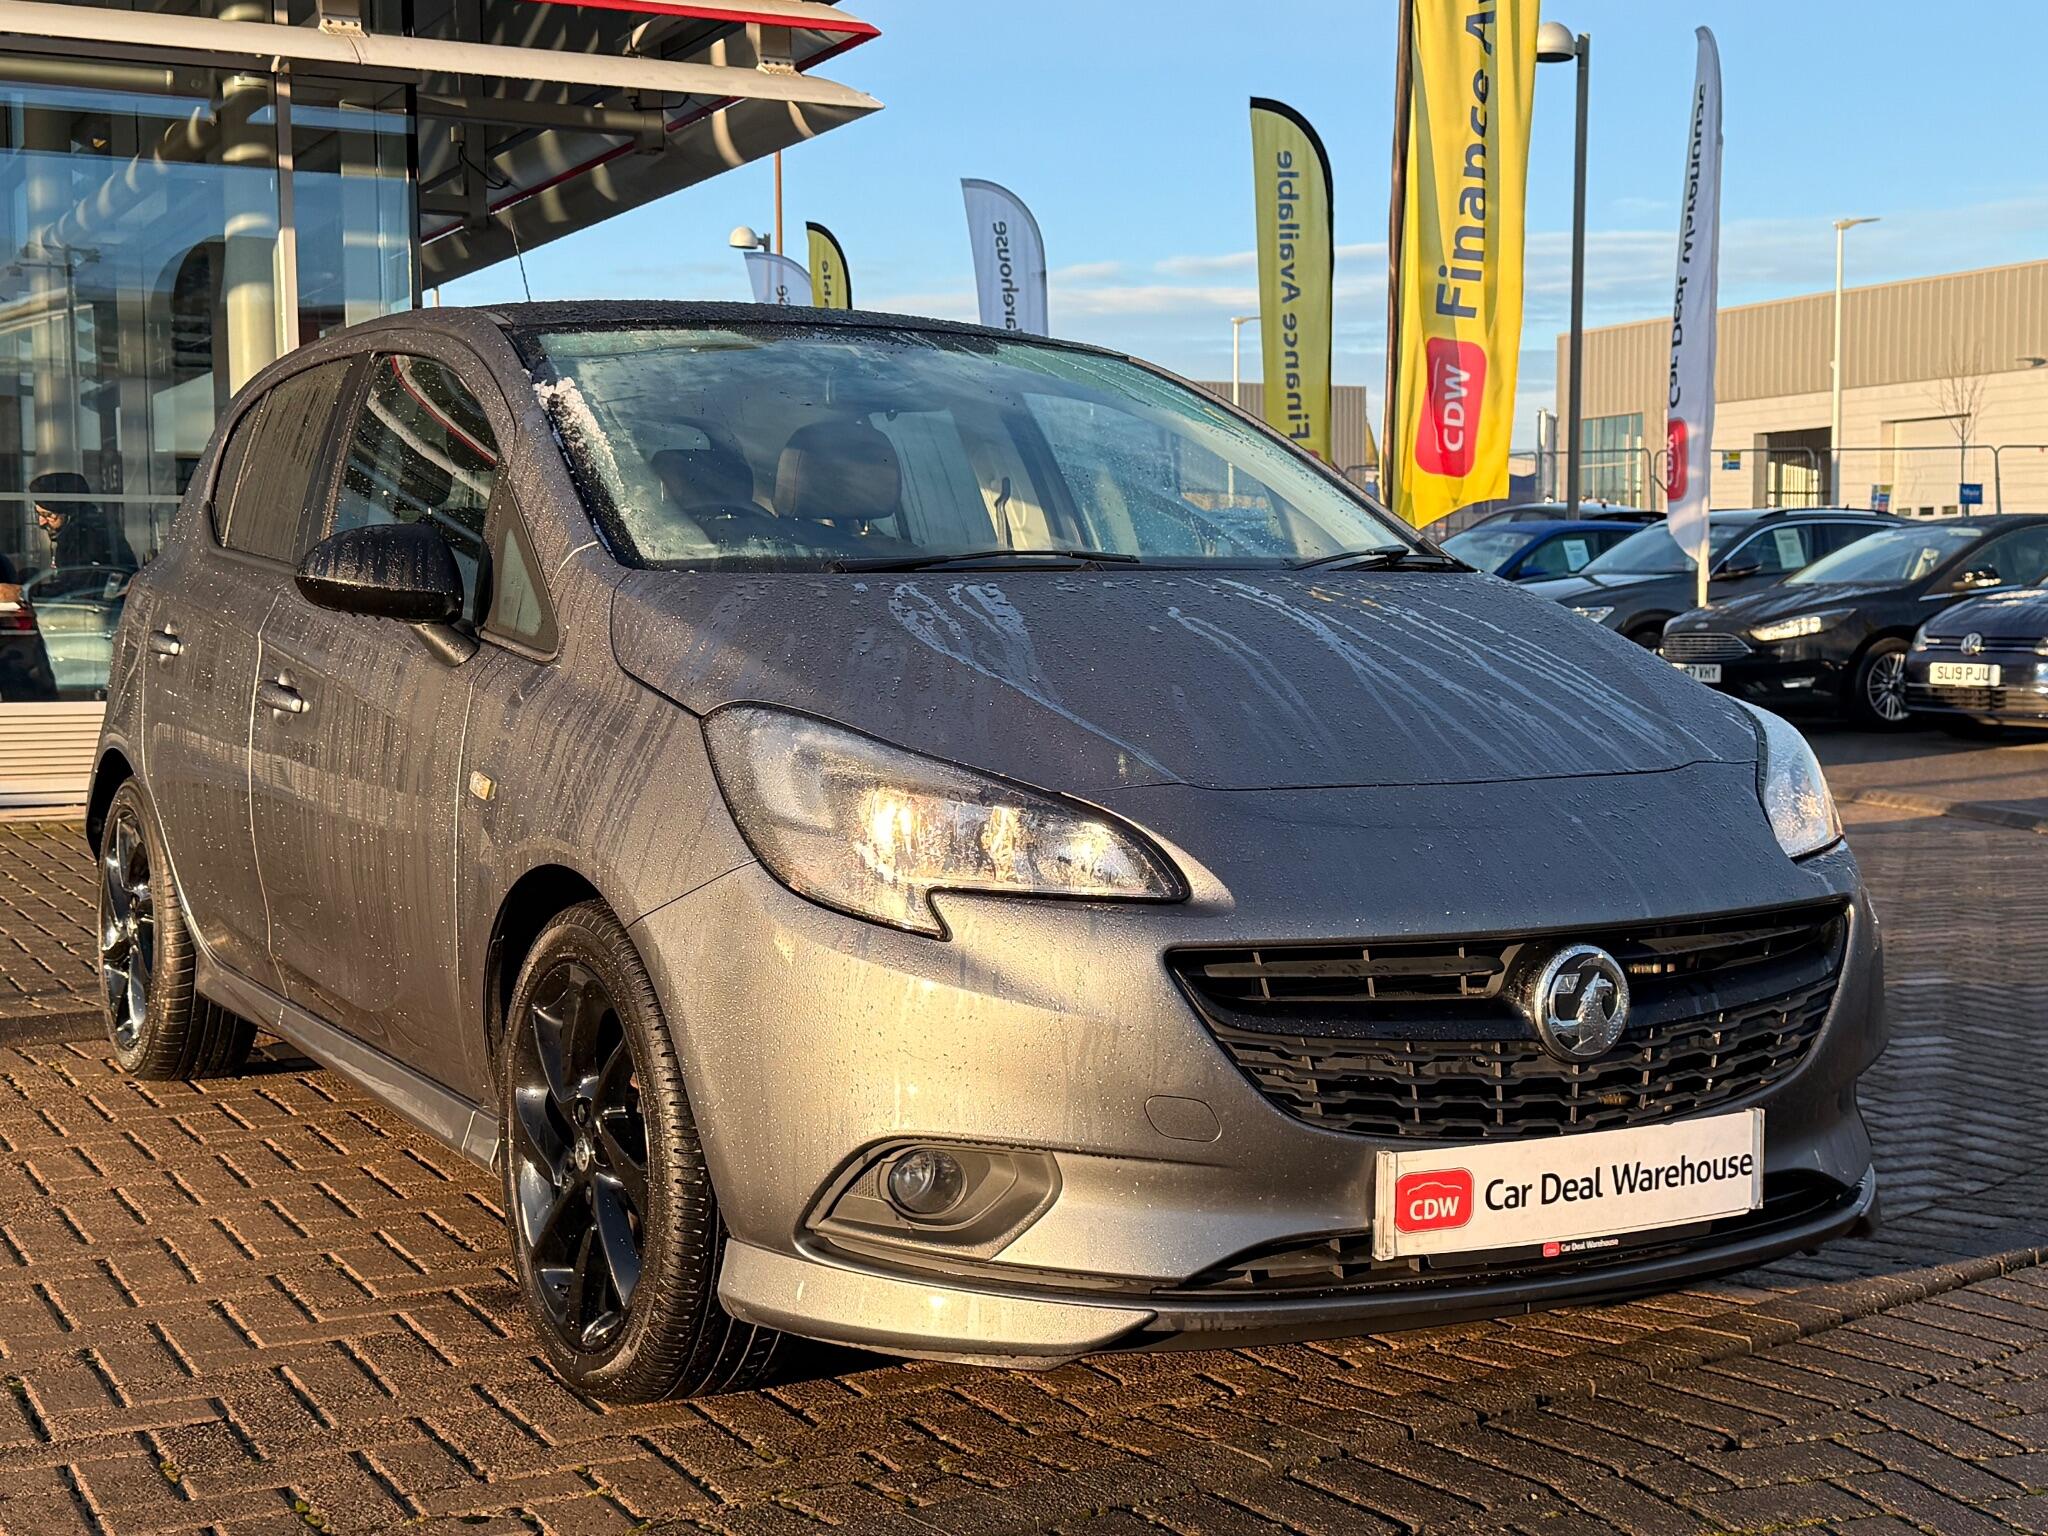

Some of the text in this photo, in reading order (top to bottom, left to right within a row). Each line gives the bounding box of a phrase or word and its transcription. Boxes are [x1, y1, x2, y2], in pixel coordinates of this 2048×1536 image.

[1436, 0, 1496, 452] CDW Finance A
[1937, 666, 1990, 681] SL19 PJU
[1409, 1153, 1753, 1221] CDW Car Deal Warehouse
